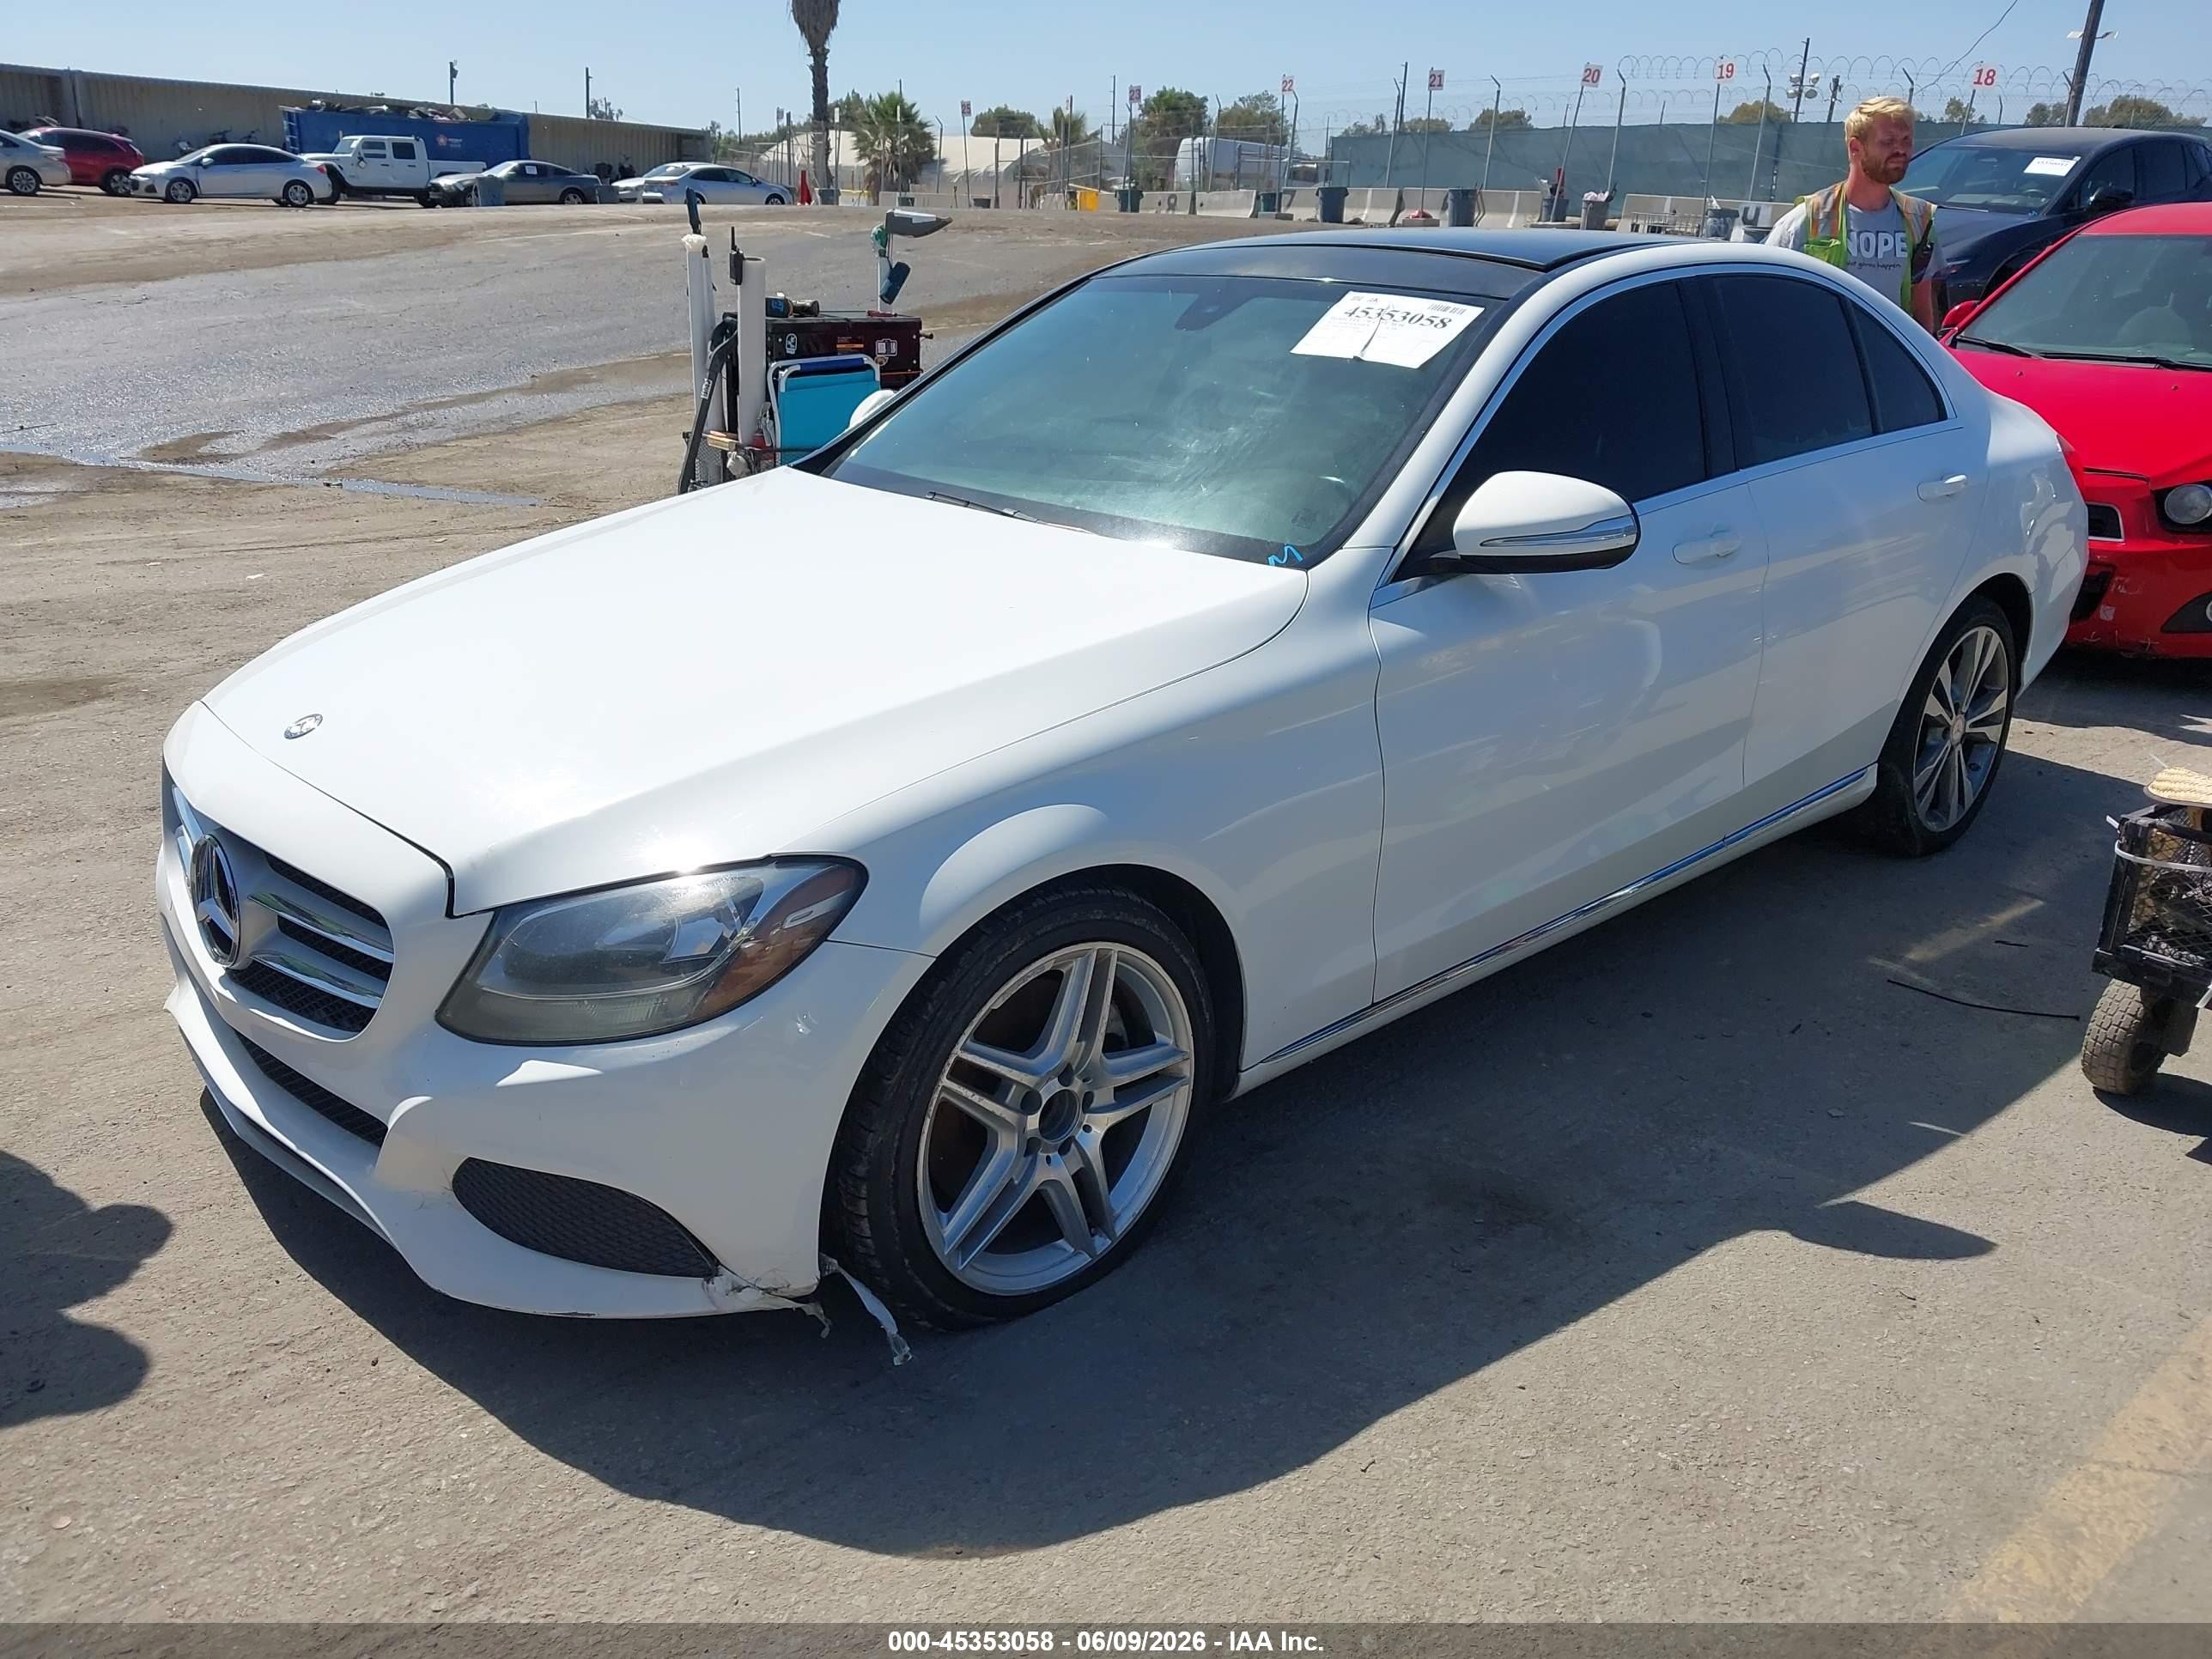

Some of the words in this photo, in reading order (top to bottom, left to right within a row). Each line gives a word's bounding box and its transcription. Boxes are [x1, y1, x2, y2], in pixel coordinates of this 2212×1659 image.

[1582, 68, 1601, 83] 20
[1717, 63, 1734, 79] 19
[1973, 68, 1996, 85] 18
[1282, 79, 1293, 92] 22
[1429, 74, 1443, 87] 21
[1129, 88, 1140, 100] 23
[1848, 231, 1908, 258] NOPE
[1344, 306, 1452, 329] 45353058
